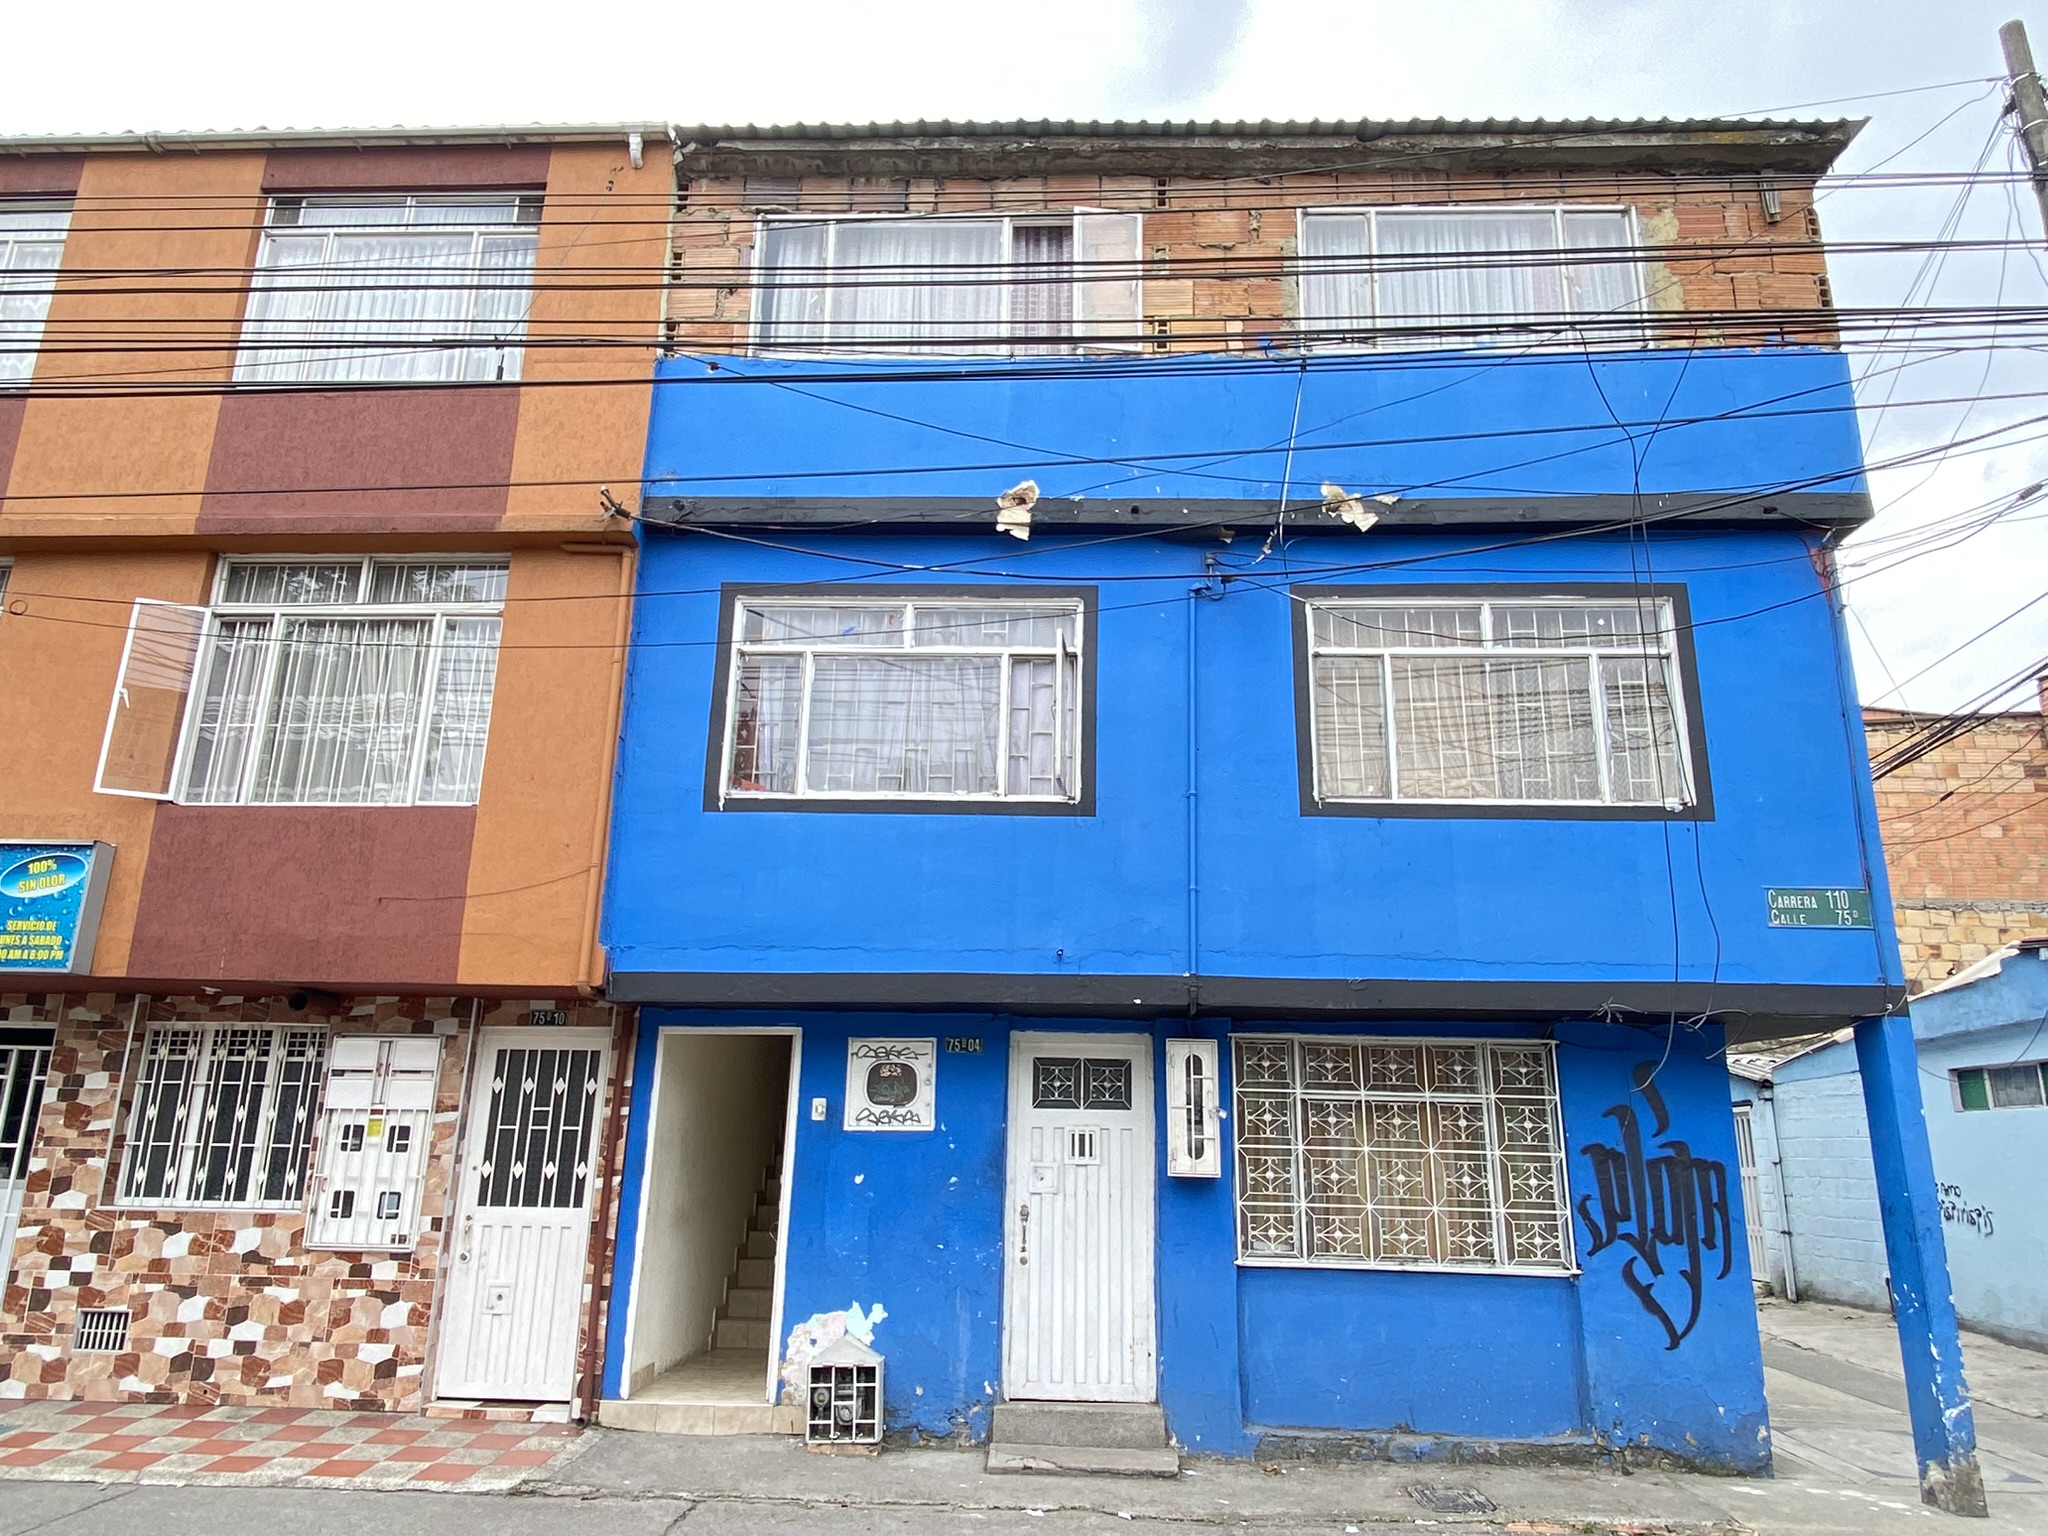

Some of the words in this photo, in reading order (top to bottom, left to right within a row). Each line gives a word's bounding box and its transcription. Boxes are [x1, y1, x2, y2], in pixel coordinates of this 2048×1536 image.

[28, 859, 57, 874] 100%
[18, 880, 36, 893] SIN
[40, 874, 66, 888] OLOR
[1825, 890, 1849, 909] 110
[7, 920, 45, 931] SERVICIO
[46, 921, 57, 931] DE
[21, 935, 28, 945] A
[28, 935, 63, 946] SABADO
[22, 950, 29, 959] A
[50, 950, 64, 960] PM
